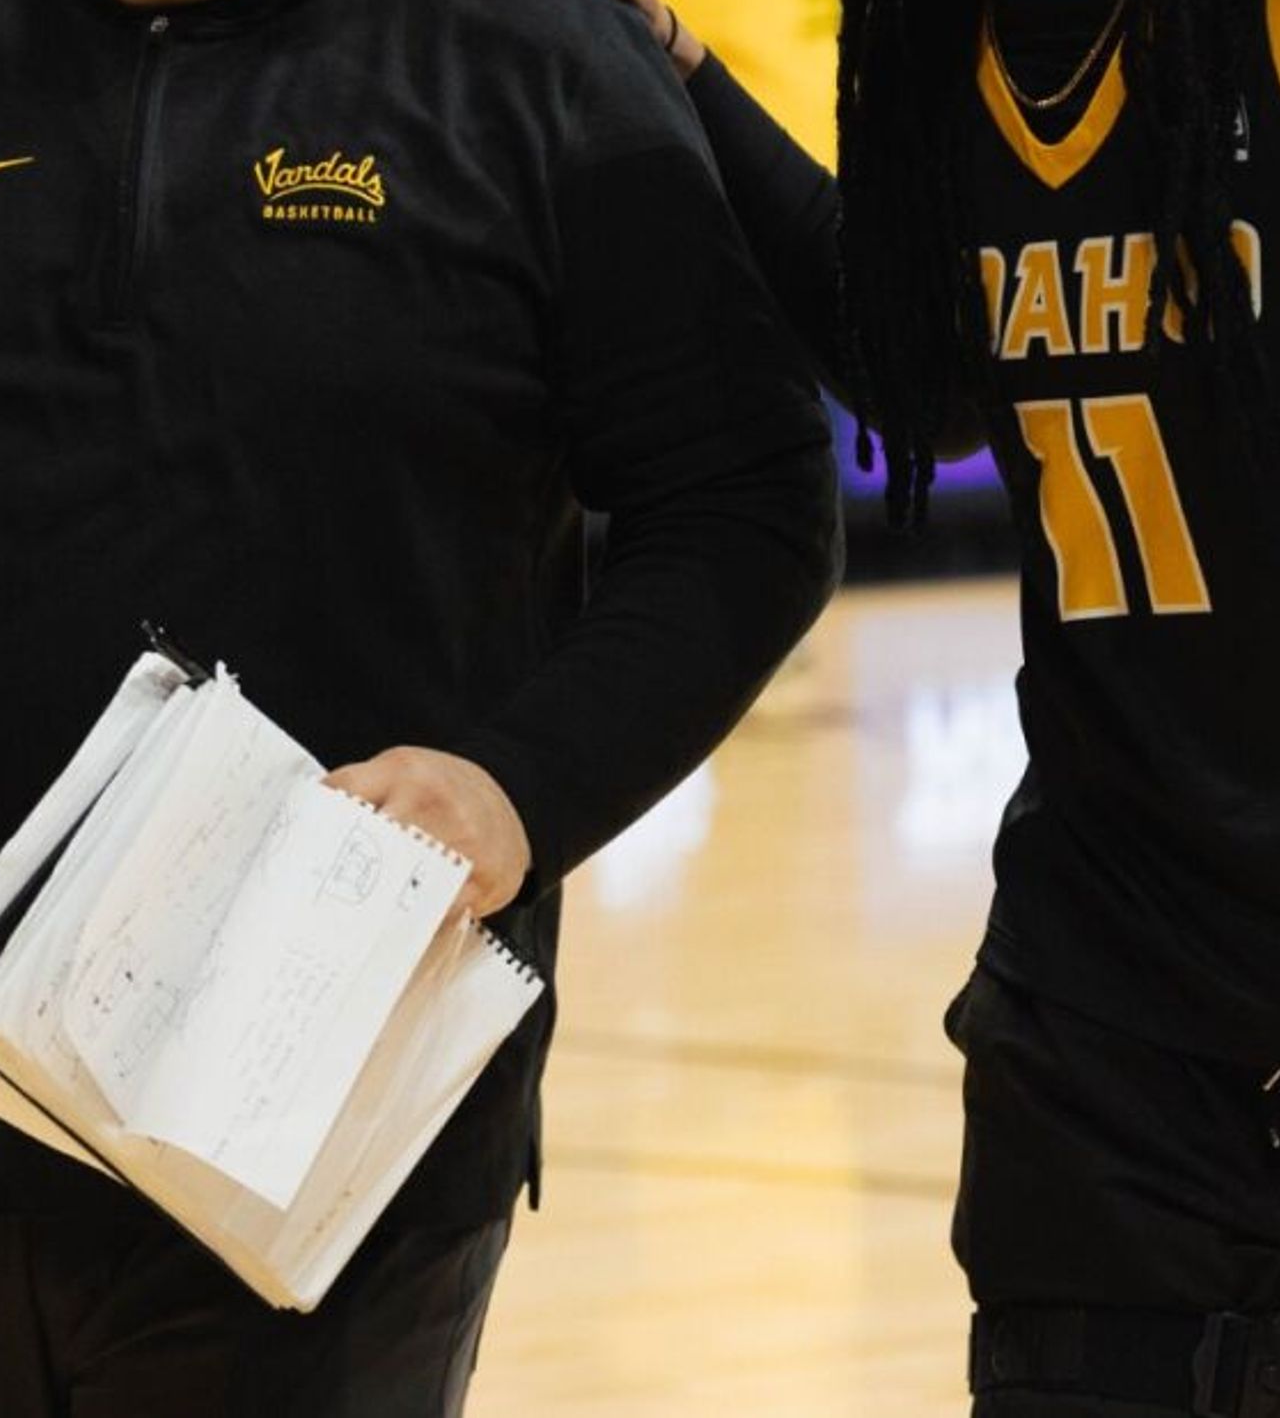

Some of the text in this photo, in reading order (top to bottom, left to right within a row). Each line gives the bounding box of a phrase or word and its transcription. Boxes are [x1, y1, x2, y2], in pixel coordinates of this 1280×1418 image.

[254, 147, 385, 205] Vandals
[263, 204, 376, 222] BASKETBALL
[1013, 393, 1212, 622] 11
